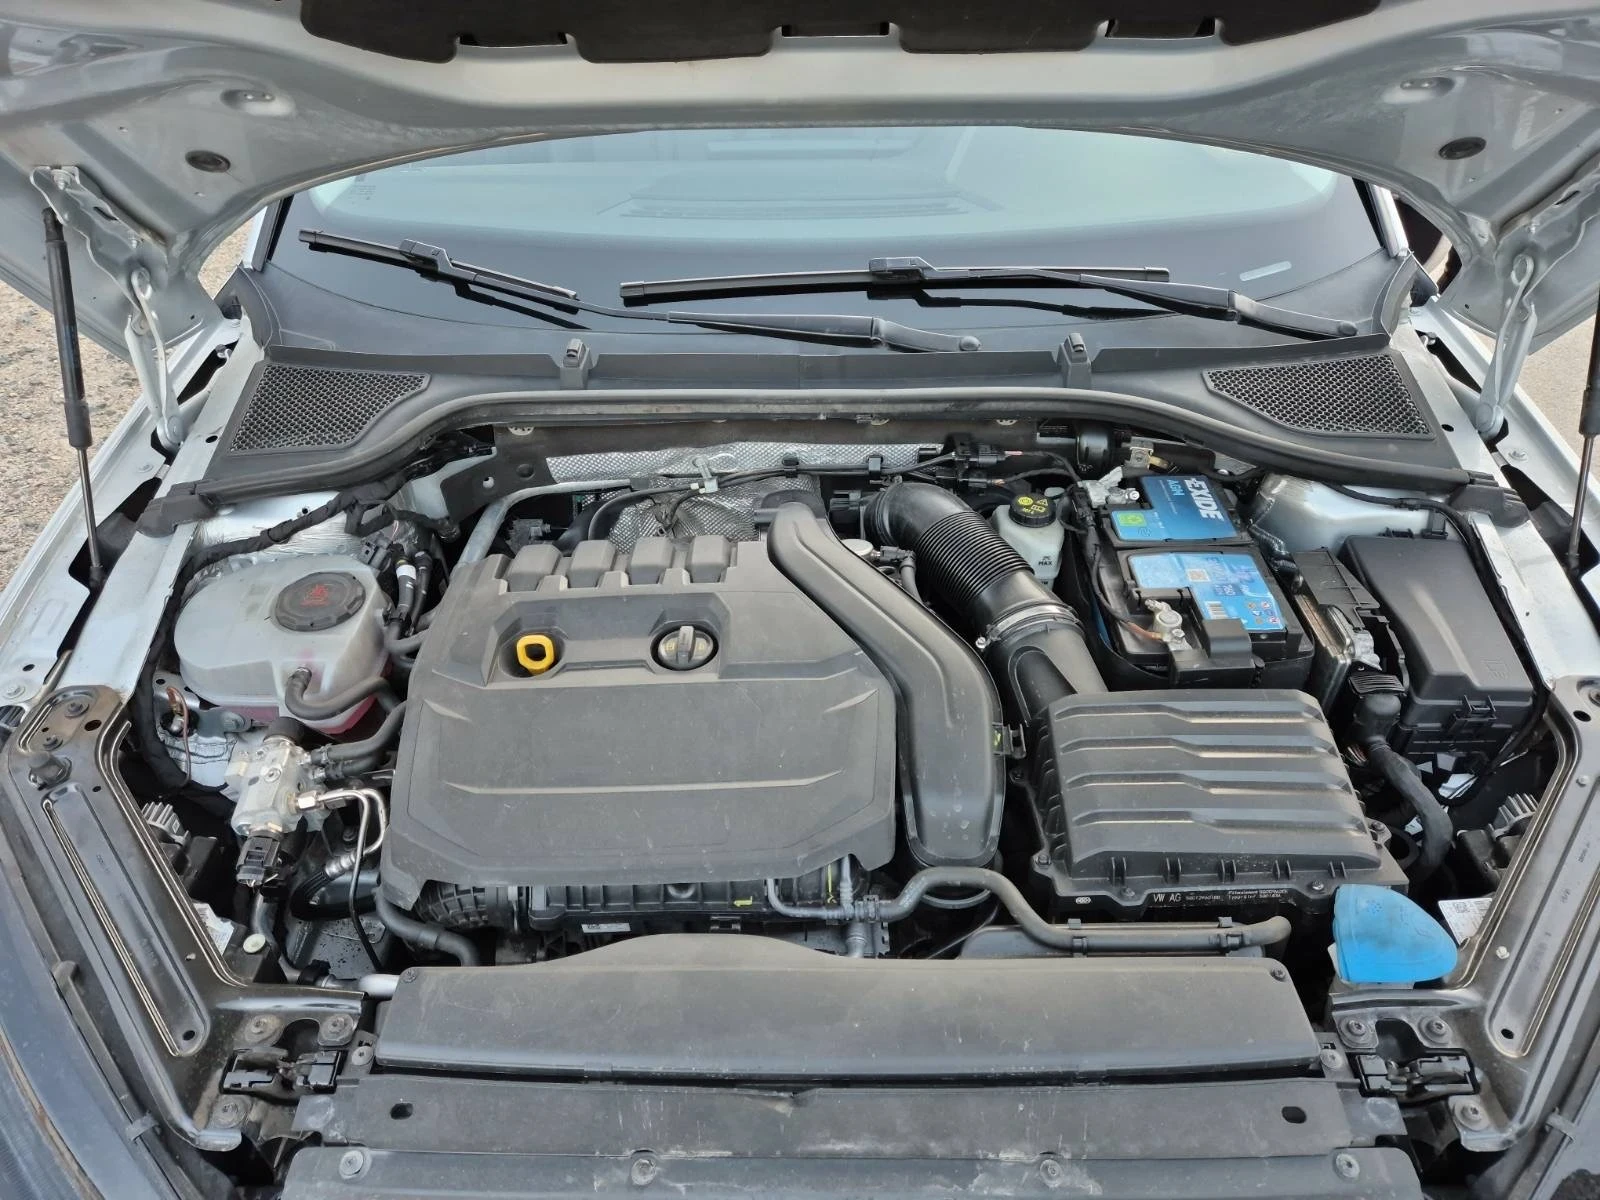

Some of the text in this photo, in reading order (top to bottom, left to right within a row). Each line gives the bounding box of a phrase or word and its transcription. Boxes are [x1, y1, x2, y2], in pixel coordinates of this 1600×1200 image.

[1167, 480, 1185, 496] AGM
[1184, 478, 1224, 521] EXIDE
[1153, 893, 1166, 902] VW
[1169, 893, 1181, 902] AG
